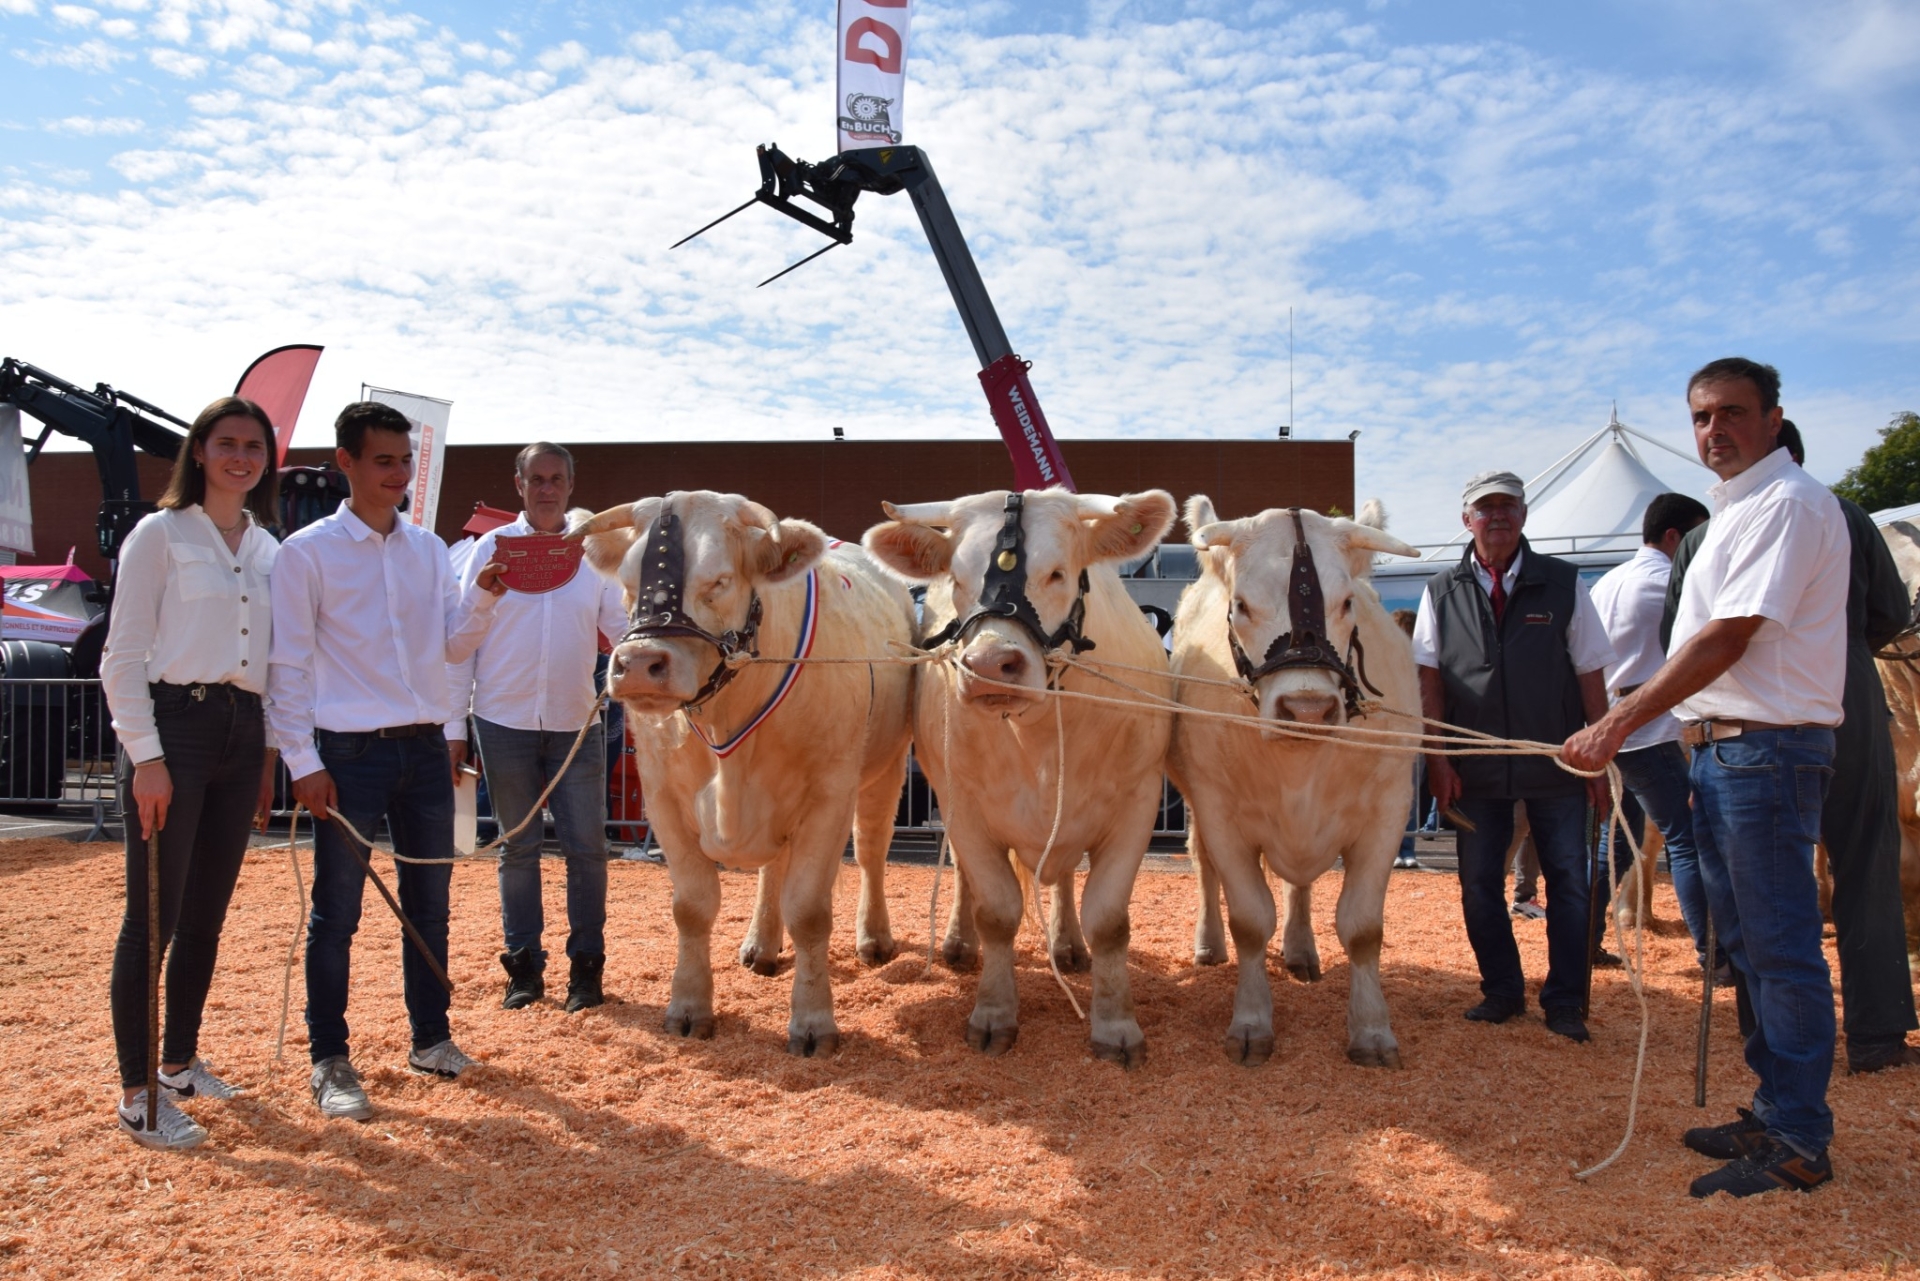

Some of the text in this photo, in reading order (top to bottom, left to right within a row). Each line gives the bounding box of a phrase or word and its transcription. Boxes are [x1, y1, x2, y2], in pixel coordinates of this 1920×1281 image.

[1008, 385, 1055, 482] WEIDEMANN
[416, 430, 433, 508] PARTICULIERS
[511, 565, 527, 573] PRIX
[518, 572, 555, 581] FEMELLES
[520, 580, 550, 589] ADULTES
